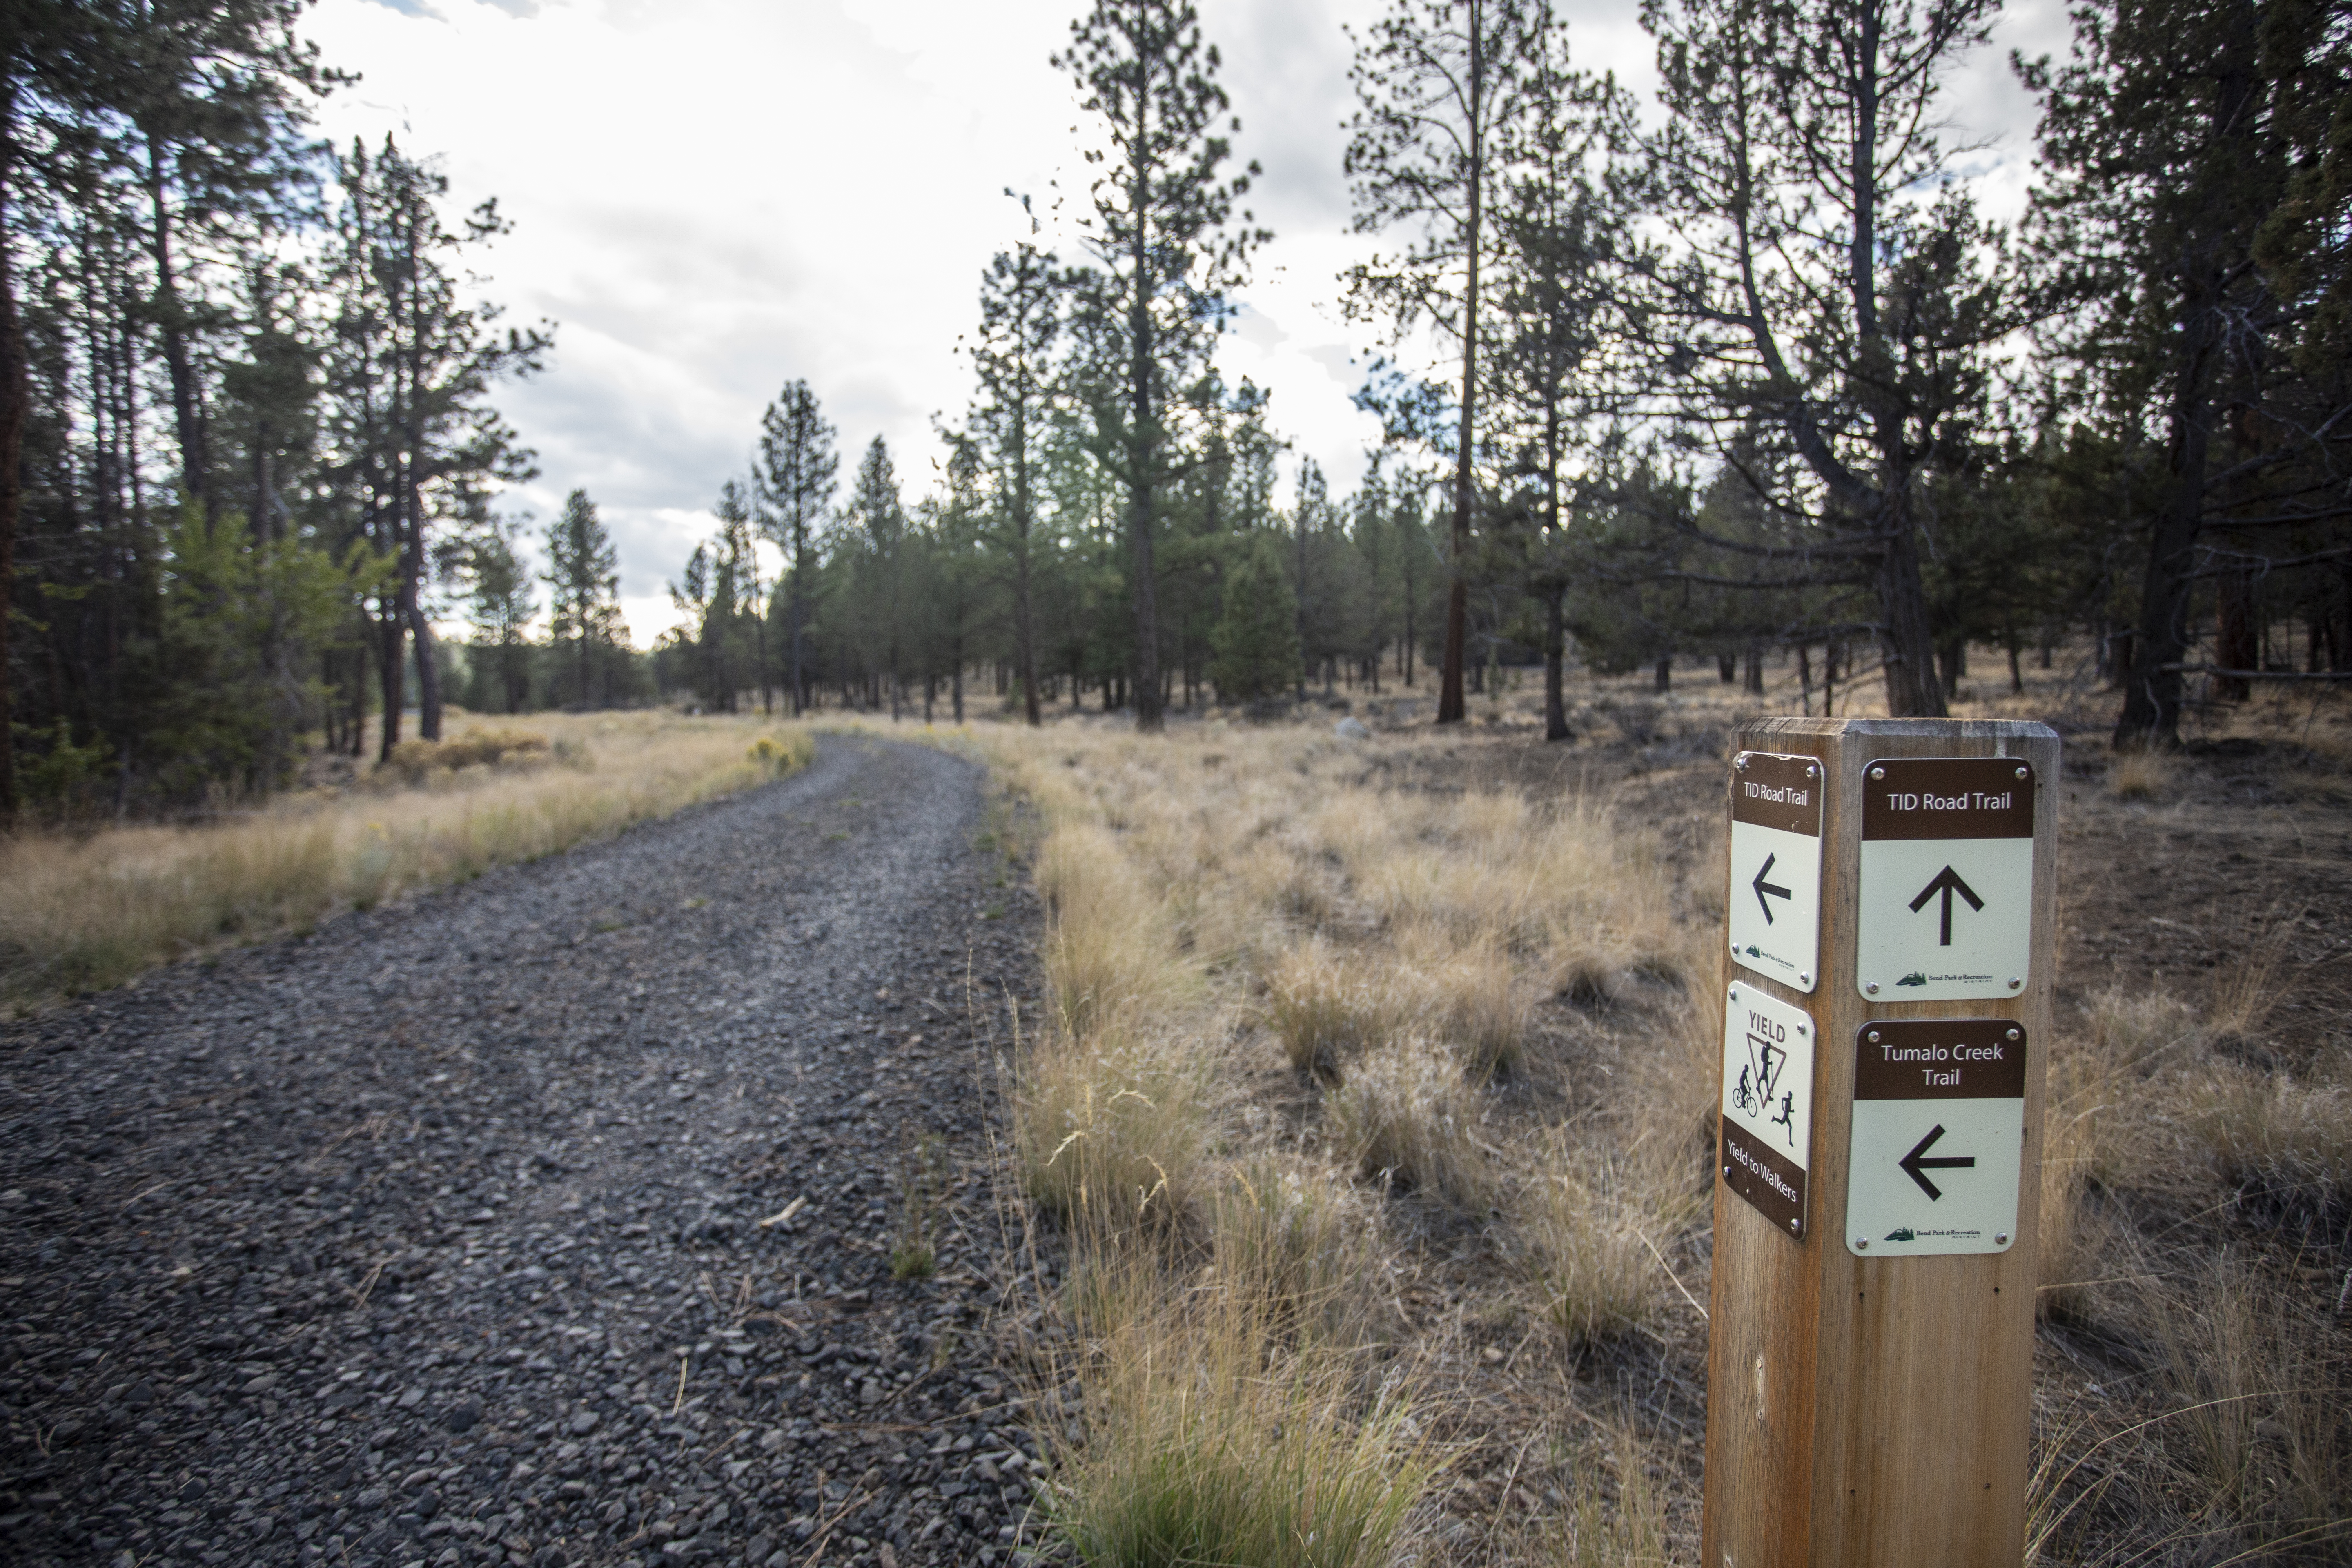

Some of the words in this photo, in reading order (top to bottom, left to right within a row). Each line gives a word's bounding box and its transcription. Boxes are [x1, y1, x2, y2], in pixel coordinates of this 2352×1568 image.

[1744, 782, 1759, 798] TID
[1761, 784, 1783, 802] Road
[1786, 788, 1807, 806] Trail
[1887, 793, 1919, 810] TID
[1923, 792, 1968, 810] Road
[1972, 792, 2011, 809] Trail
[1778, 958, 1794, 968] Recreation
[1749, 1009, 1785, 1043] YIELD
[1881, 1044, 1949, 1061] Tumalo
[1953, 1043, 2003, 1060] Creek
[1922, 1068, 1961, 1085] Trail
[1728, 1139, 1748, 1167] Yield
[1750, 1157, 1758, 1174] to
[1760, 1163, 1797, 1202] Walkers
